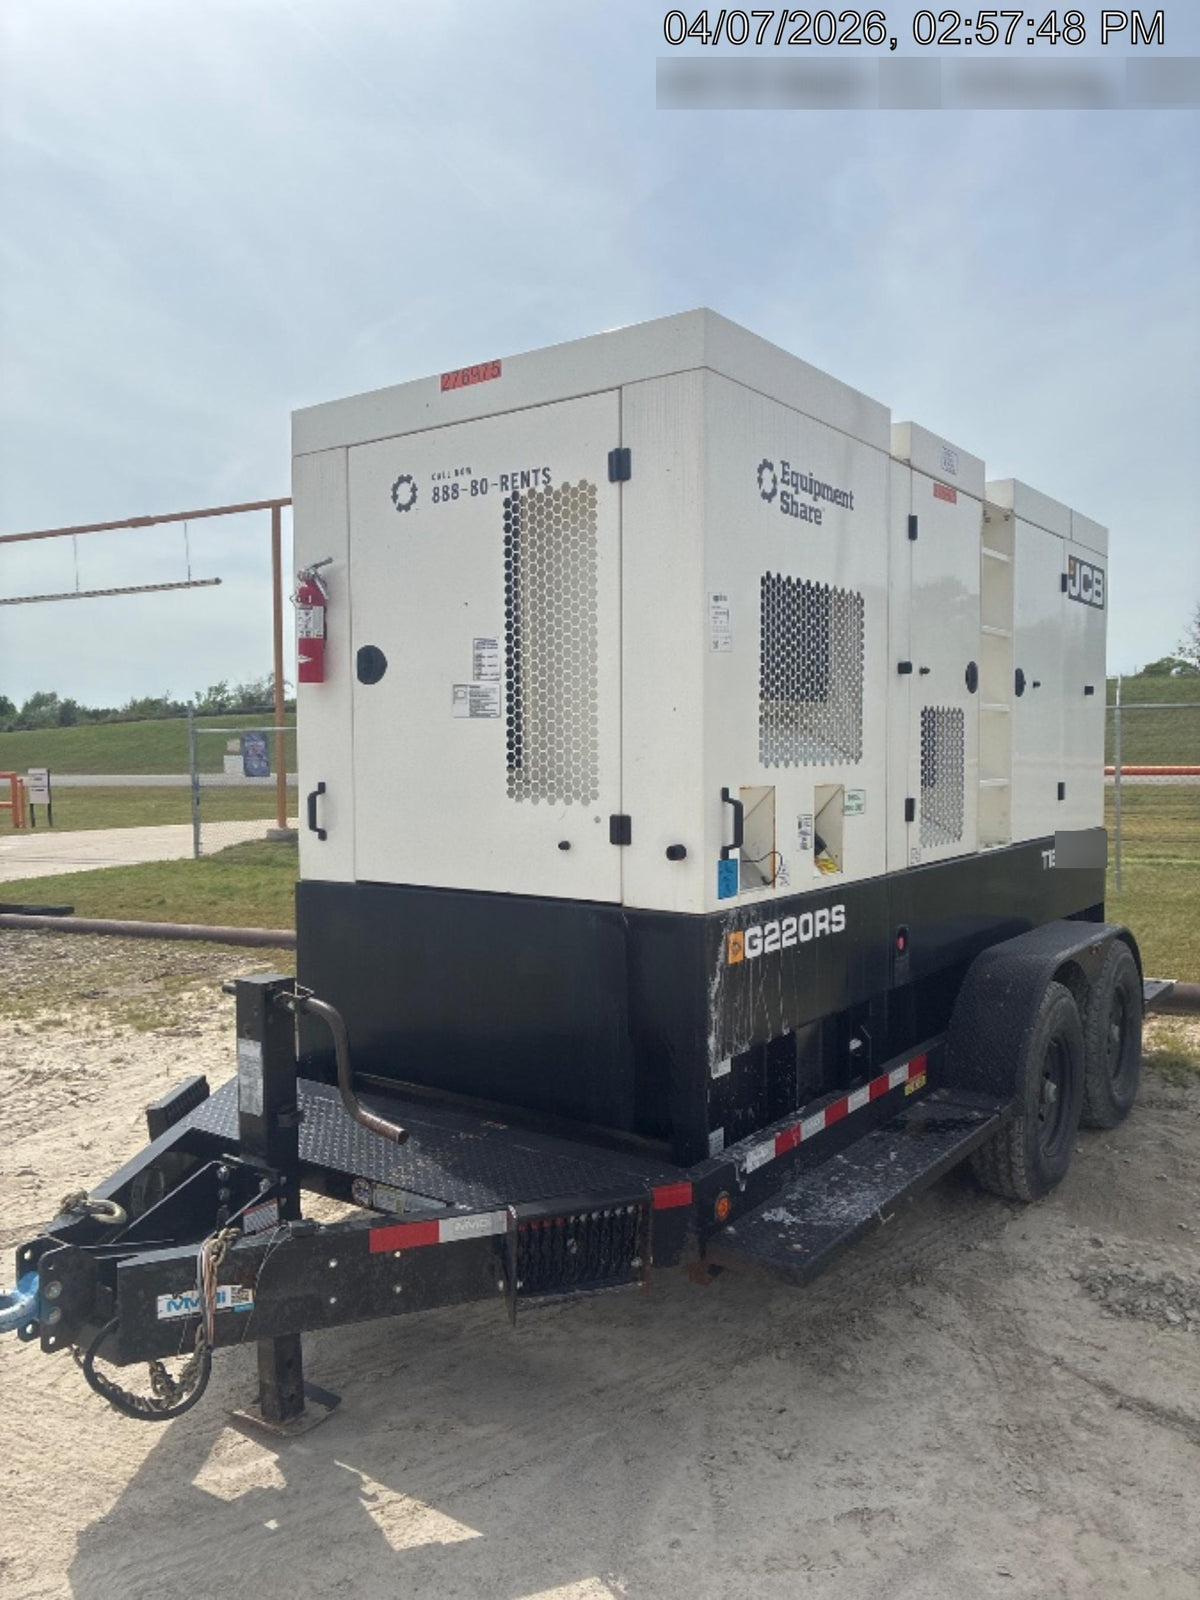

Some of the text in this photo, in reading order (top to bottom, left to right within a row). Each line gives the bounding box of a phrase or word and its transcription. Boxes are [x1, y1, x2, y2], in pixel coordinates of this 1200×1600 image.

[432, 466, 552, 504] 888-80-RENTS
[780, 460, 854, 511] Equipment
[780, 490, 823, 526] Share
[1069, 556, 1104, 609] JCB
[745, 904, 846, 959] G220RS
